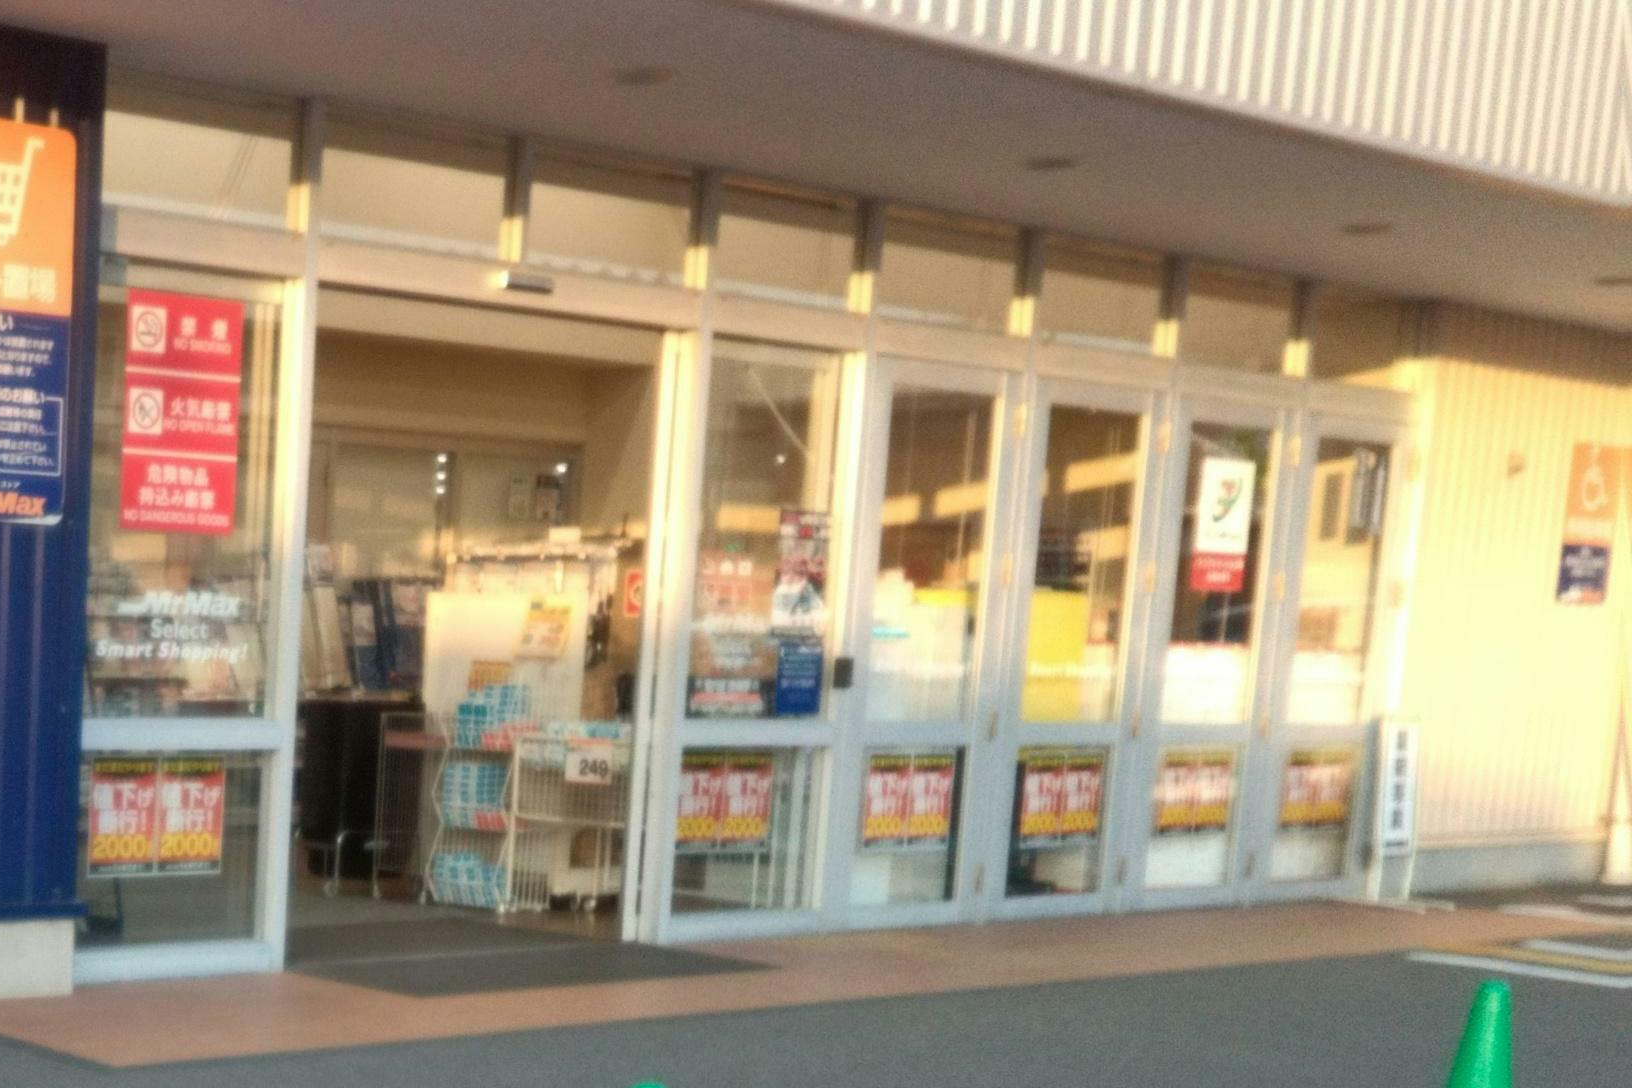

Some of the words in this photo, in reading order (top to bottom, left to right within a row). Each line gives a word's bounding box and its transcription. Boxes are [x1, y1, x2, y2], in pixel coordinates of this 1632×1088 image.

[118, 590, 240, 618] MrMax
[150, 618, 209, 640] Select
[96, 639, 153, 659] Smart
[157, 641, 248, 664] Shopping!
[579, 758, 609, 778] 249
